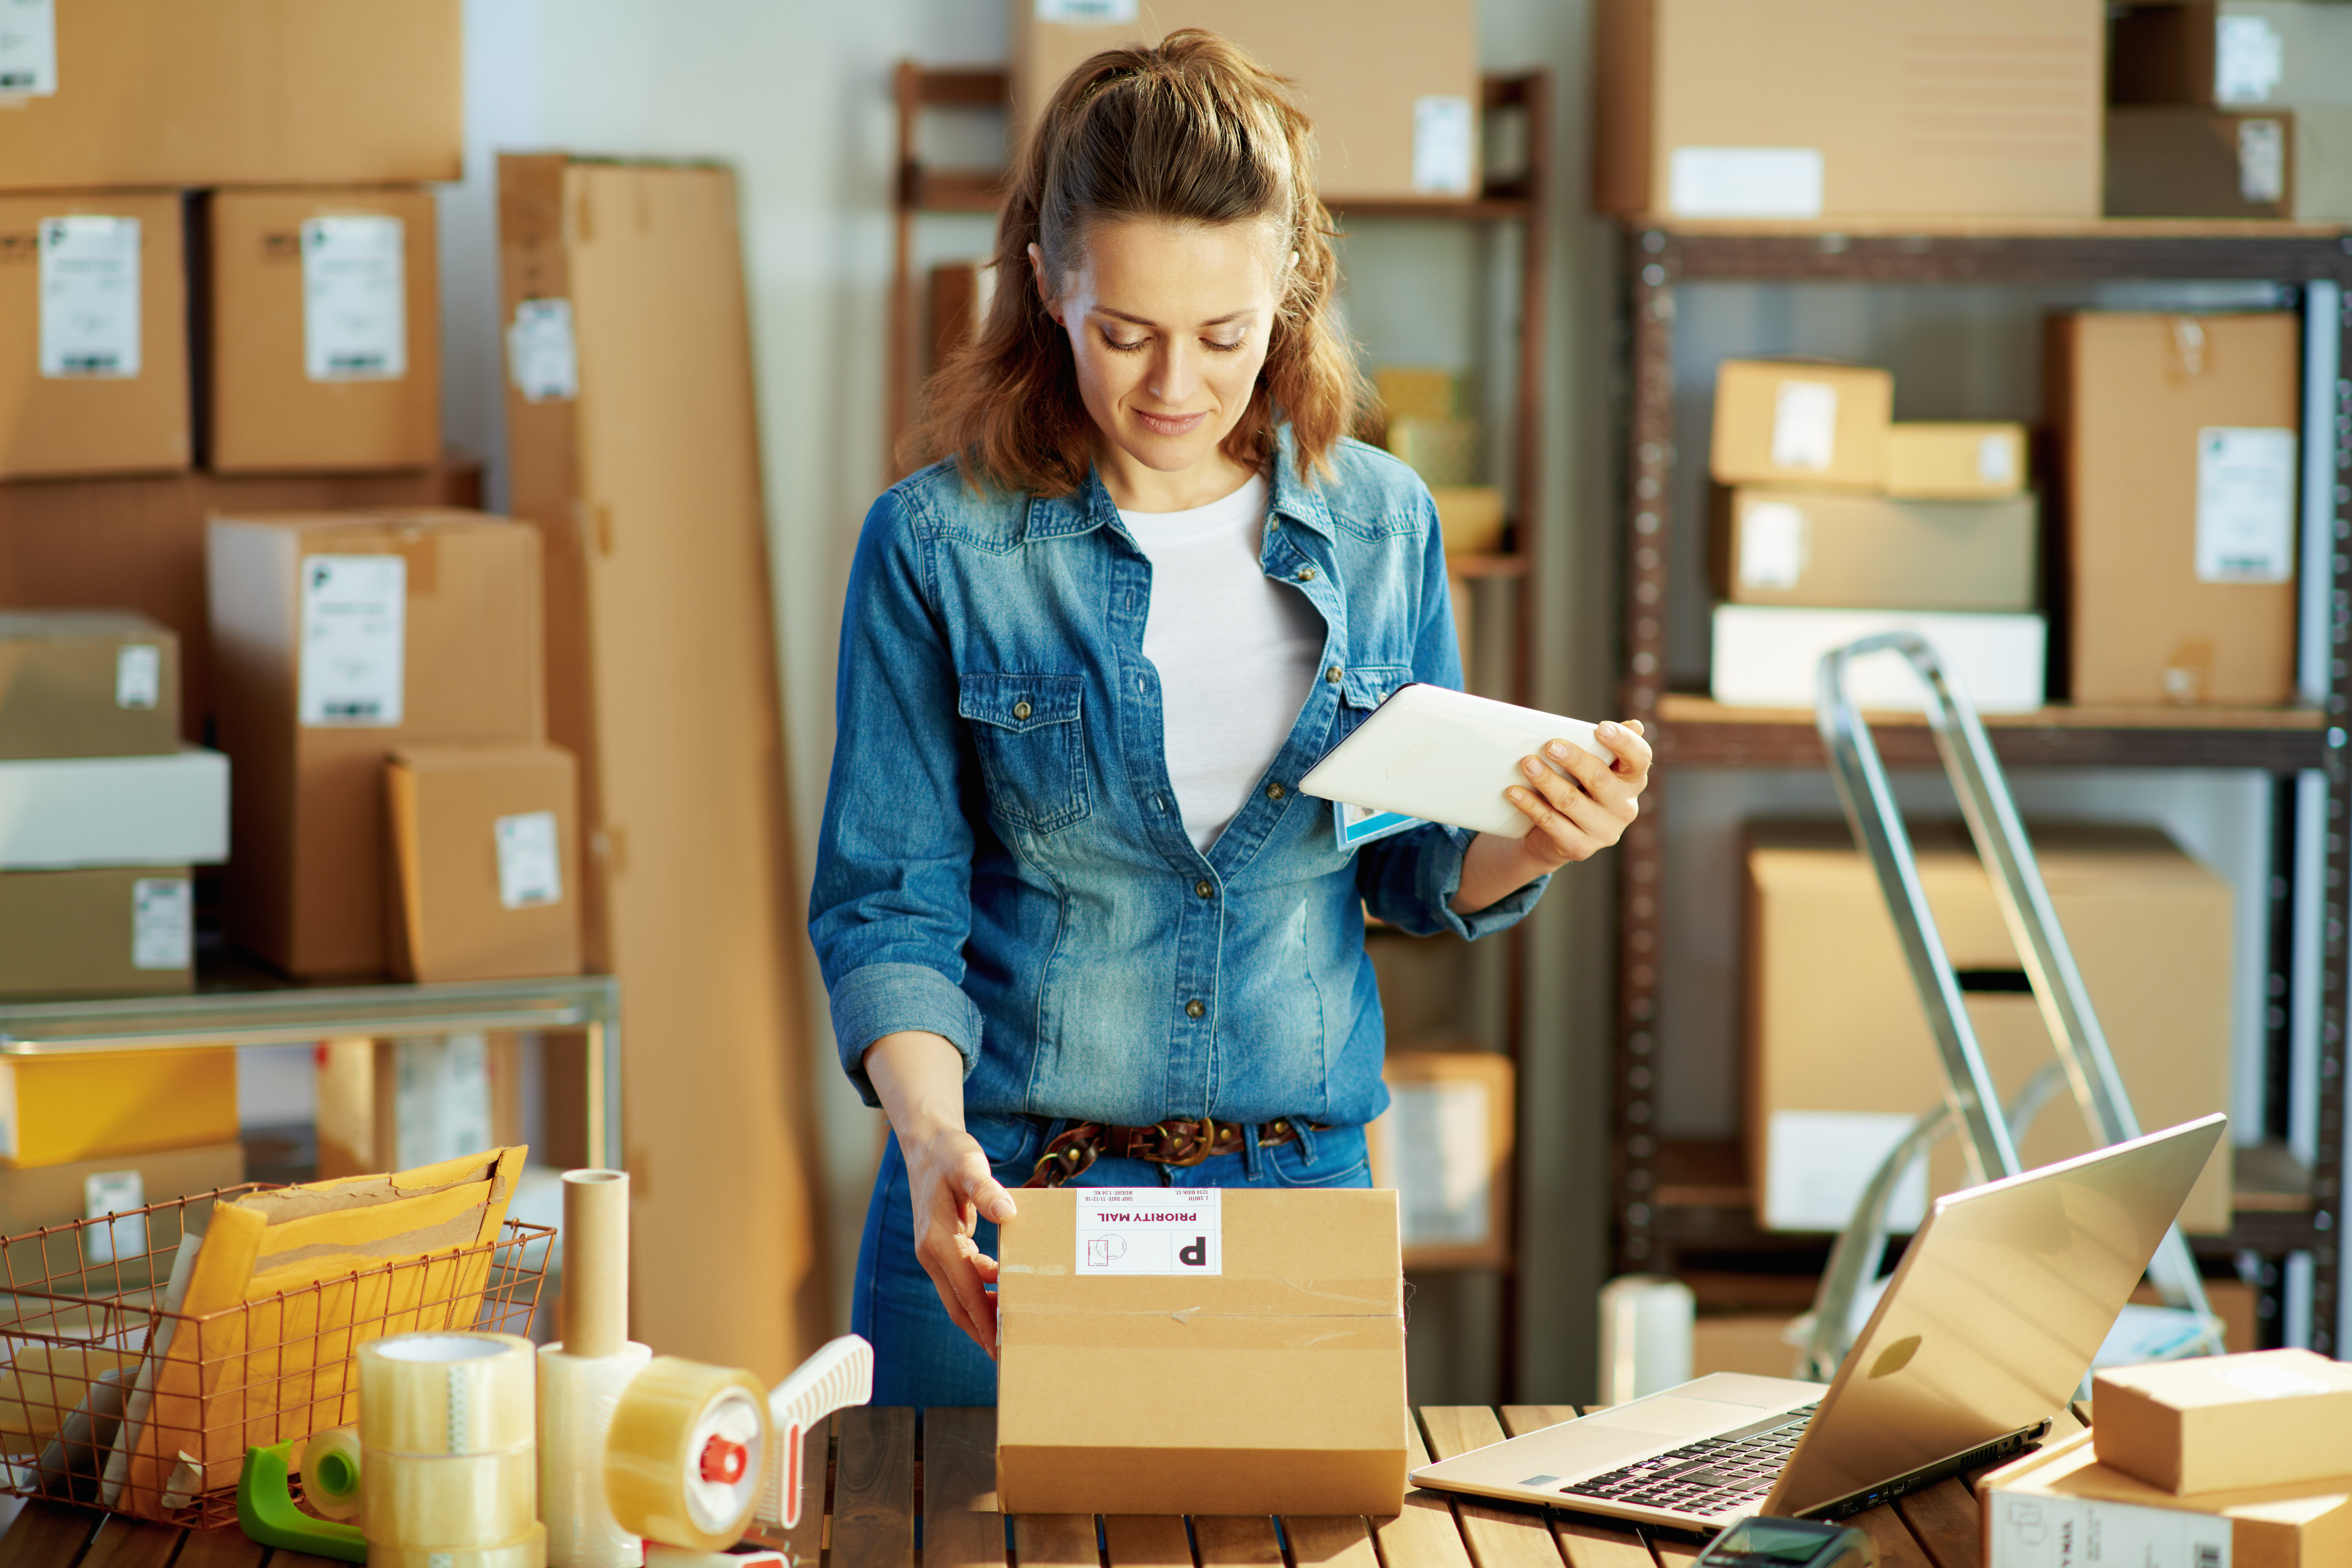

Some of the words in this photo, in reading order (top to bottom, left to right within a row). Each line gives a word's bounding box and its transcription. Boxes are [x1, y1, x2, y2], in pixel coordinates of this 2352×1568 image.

[1097, 1213, 1130, 1222] MAIL
[1133, 1212, 1196, 1221] PRIORITY
[1179, 1236, 1206, 1266] P
